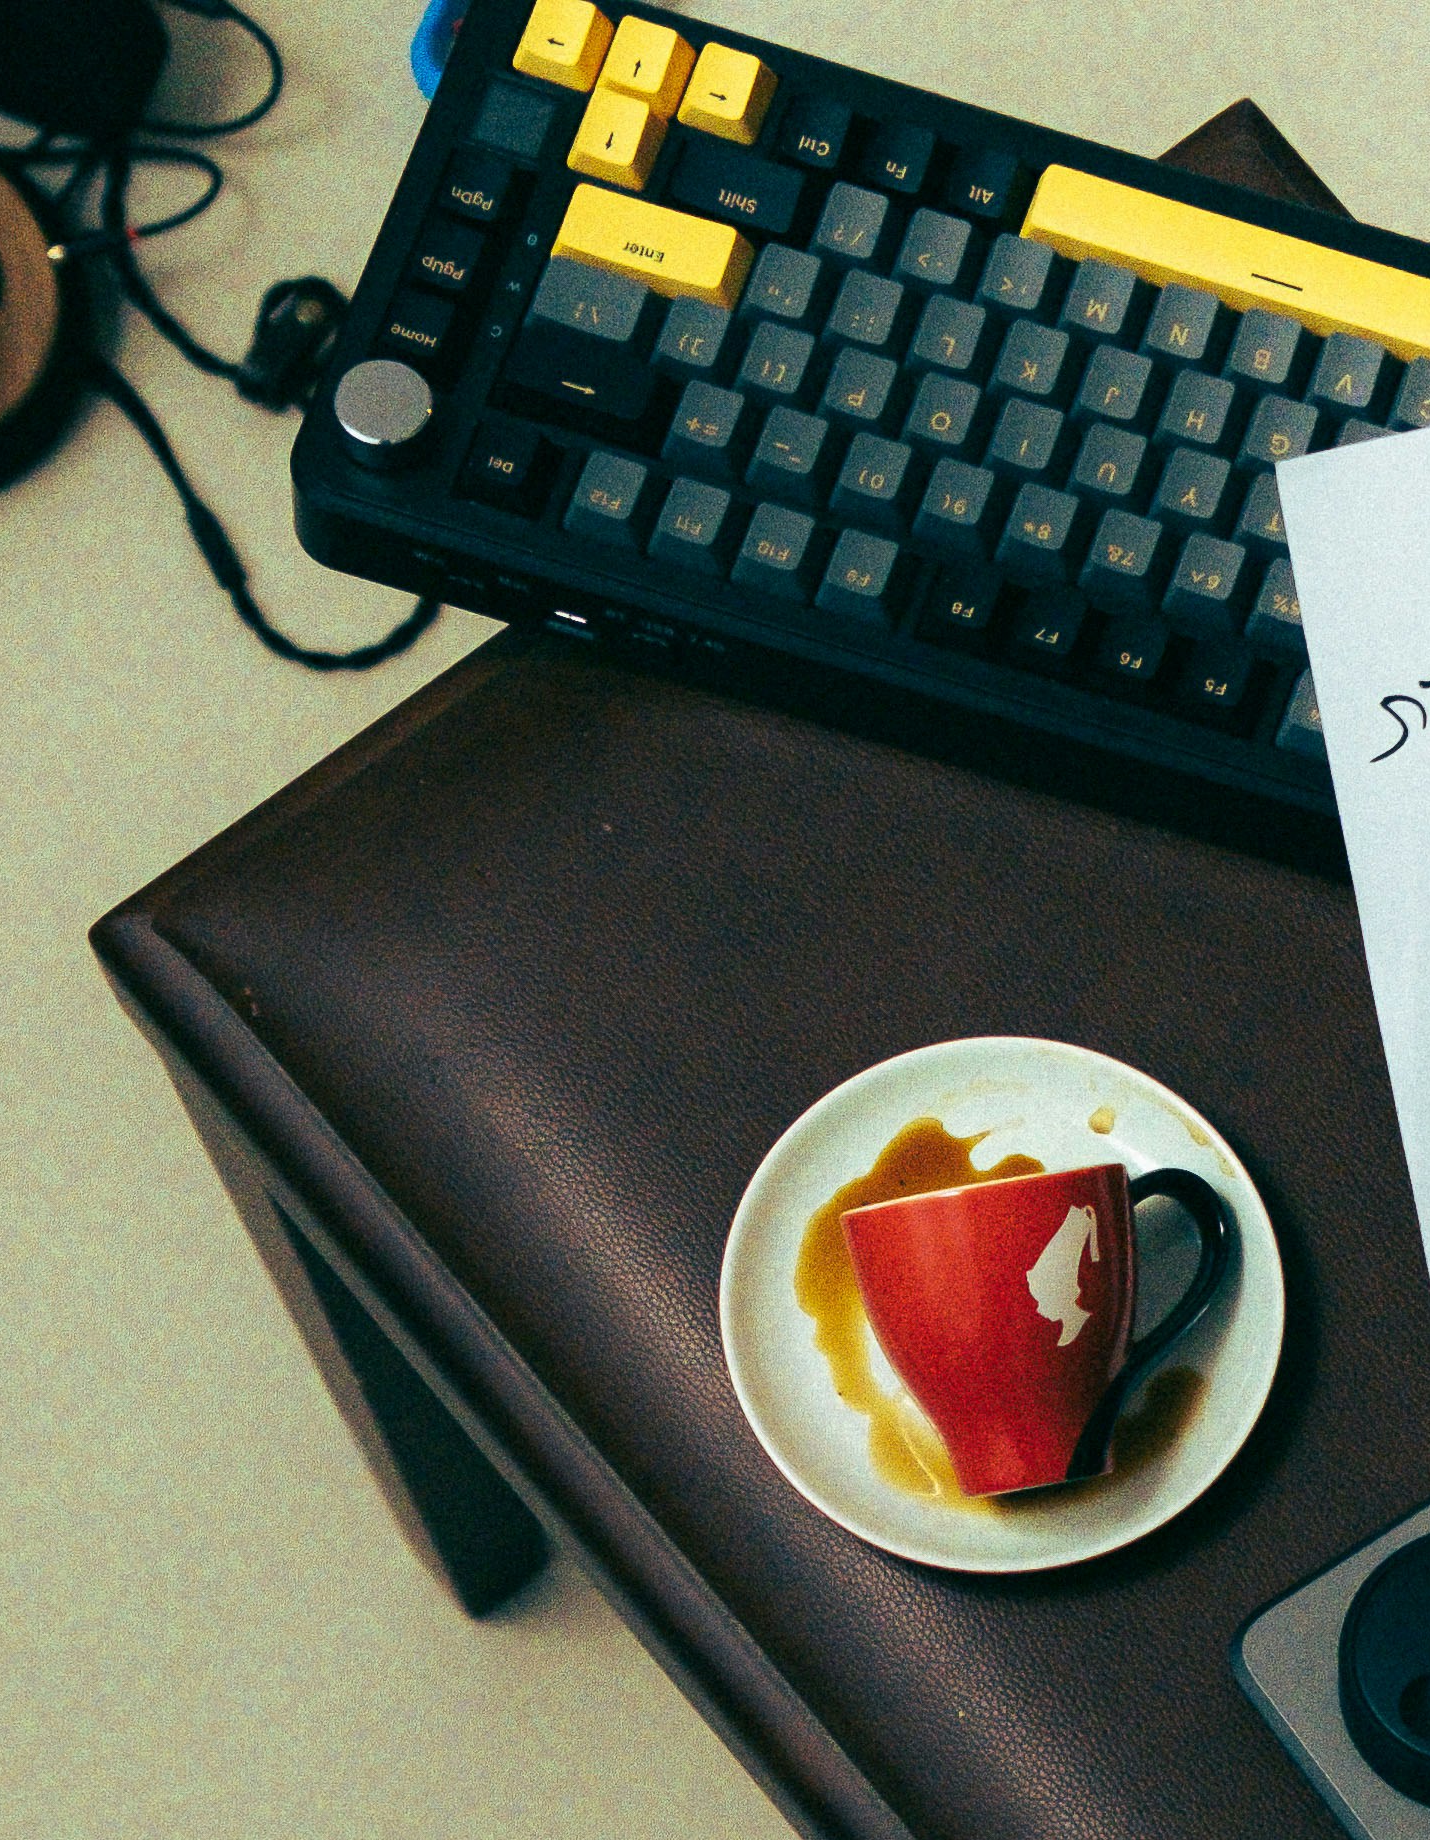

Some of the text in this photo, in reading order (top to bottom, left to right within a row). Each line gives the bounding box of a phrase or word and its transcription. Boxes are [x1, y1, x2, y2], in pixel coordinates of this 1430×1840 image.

[799, 136, 830, 156] Ctrl
[886, 161, 907, 179] Fn
[452, 187, 493, 211] PgDn
[719, 189, 757, 213] Shift
[969, 185, 994, 204] Alt
[624, 242, 665, 263] Enter
[422, 256, 464, 280] PgUp
[1087, 299, 1108, 321] M
[391, 323, 437, 347] Home
[1170, 325, 1189, 346] N
[940, 335, 956, 356] L
[1254, 349, 1271, 370] B
[1022, 361, 1037, 381] K
[1335, 372, 1354, 395] V
[846, 387, 866, 407] P
[1104, 386, 1121, 404] J
[929, 410, 952, 432] O
[1186, 411, 1206, 431] H
[1268, 432, 1292, 456] G
[489, 457, 514, 473] Del
[1097, 461, 1117, 483] U
[591, 490, 621, 509] F12
[1181, 487, 1197, 507] Y
[676, 516, 702, 535] F11
[1266, 514, 1279, 532] T
[758, 541, 790, 561] F10
[847, 569, 871, 587] F9
[952, 602, 974, 618] F8
[1035, 629, 1059, 644] F7
[1120, 652, 1142, 669] F6
[1205, 679, 1227, 695] F5
